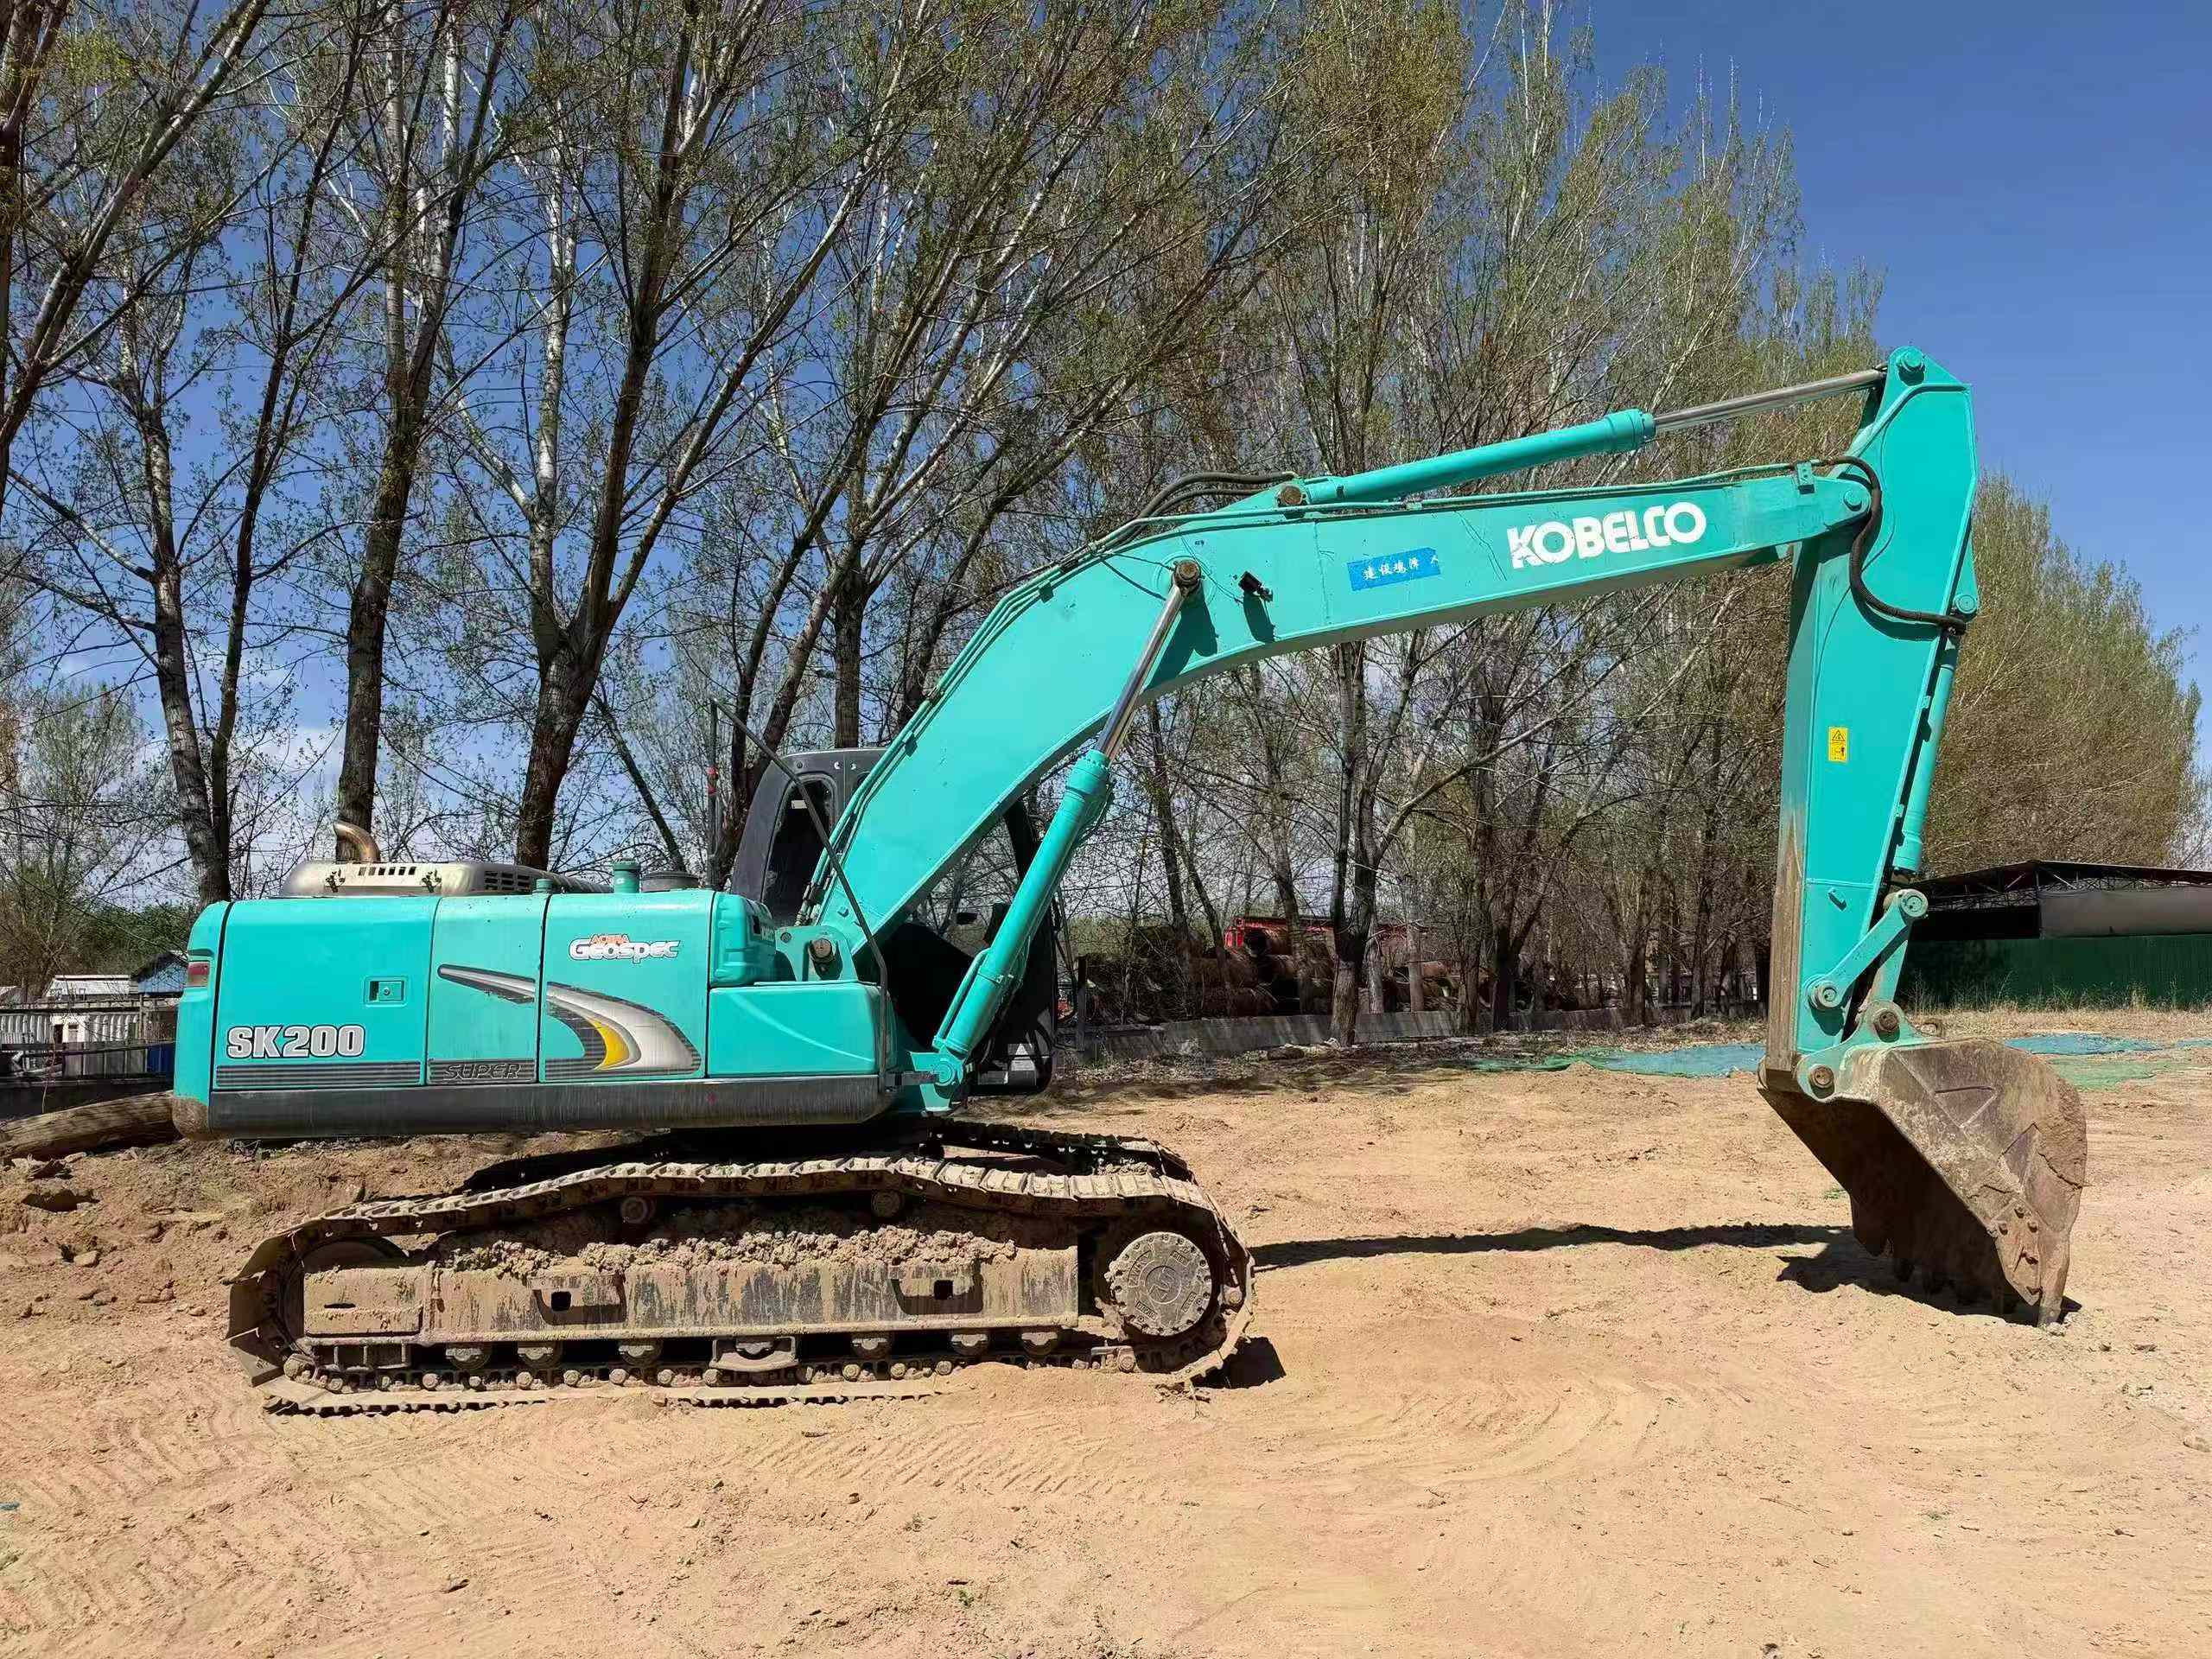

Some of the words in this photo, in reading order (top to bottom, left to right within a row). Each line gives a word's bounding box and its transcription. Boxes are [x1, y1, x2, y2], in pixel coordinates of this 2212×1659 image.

[1506, 501, 1707, 569] KOBELCO
[569, 938, 681, 963] Geospec
[226, 1024, 365, 1059] SK200
[443, 1063, 521, 1081] SUPER
